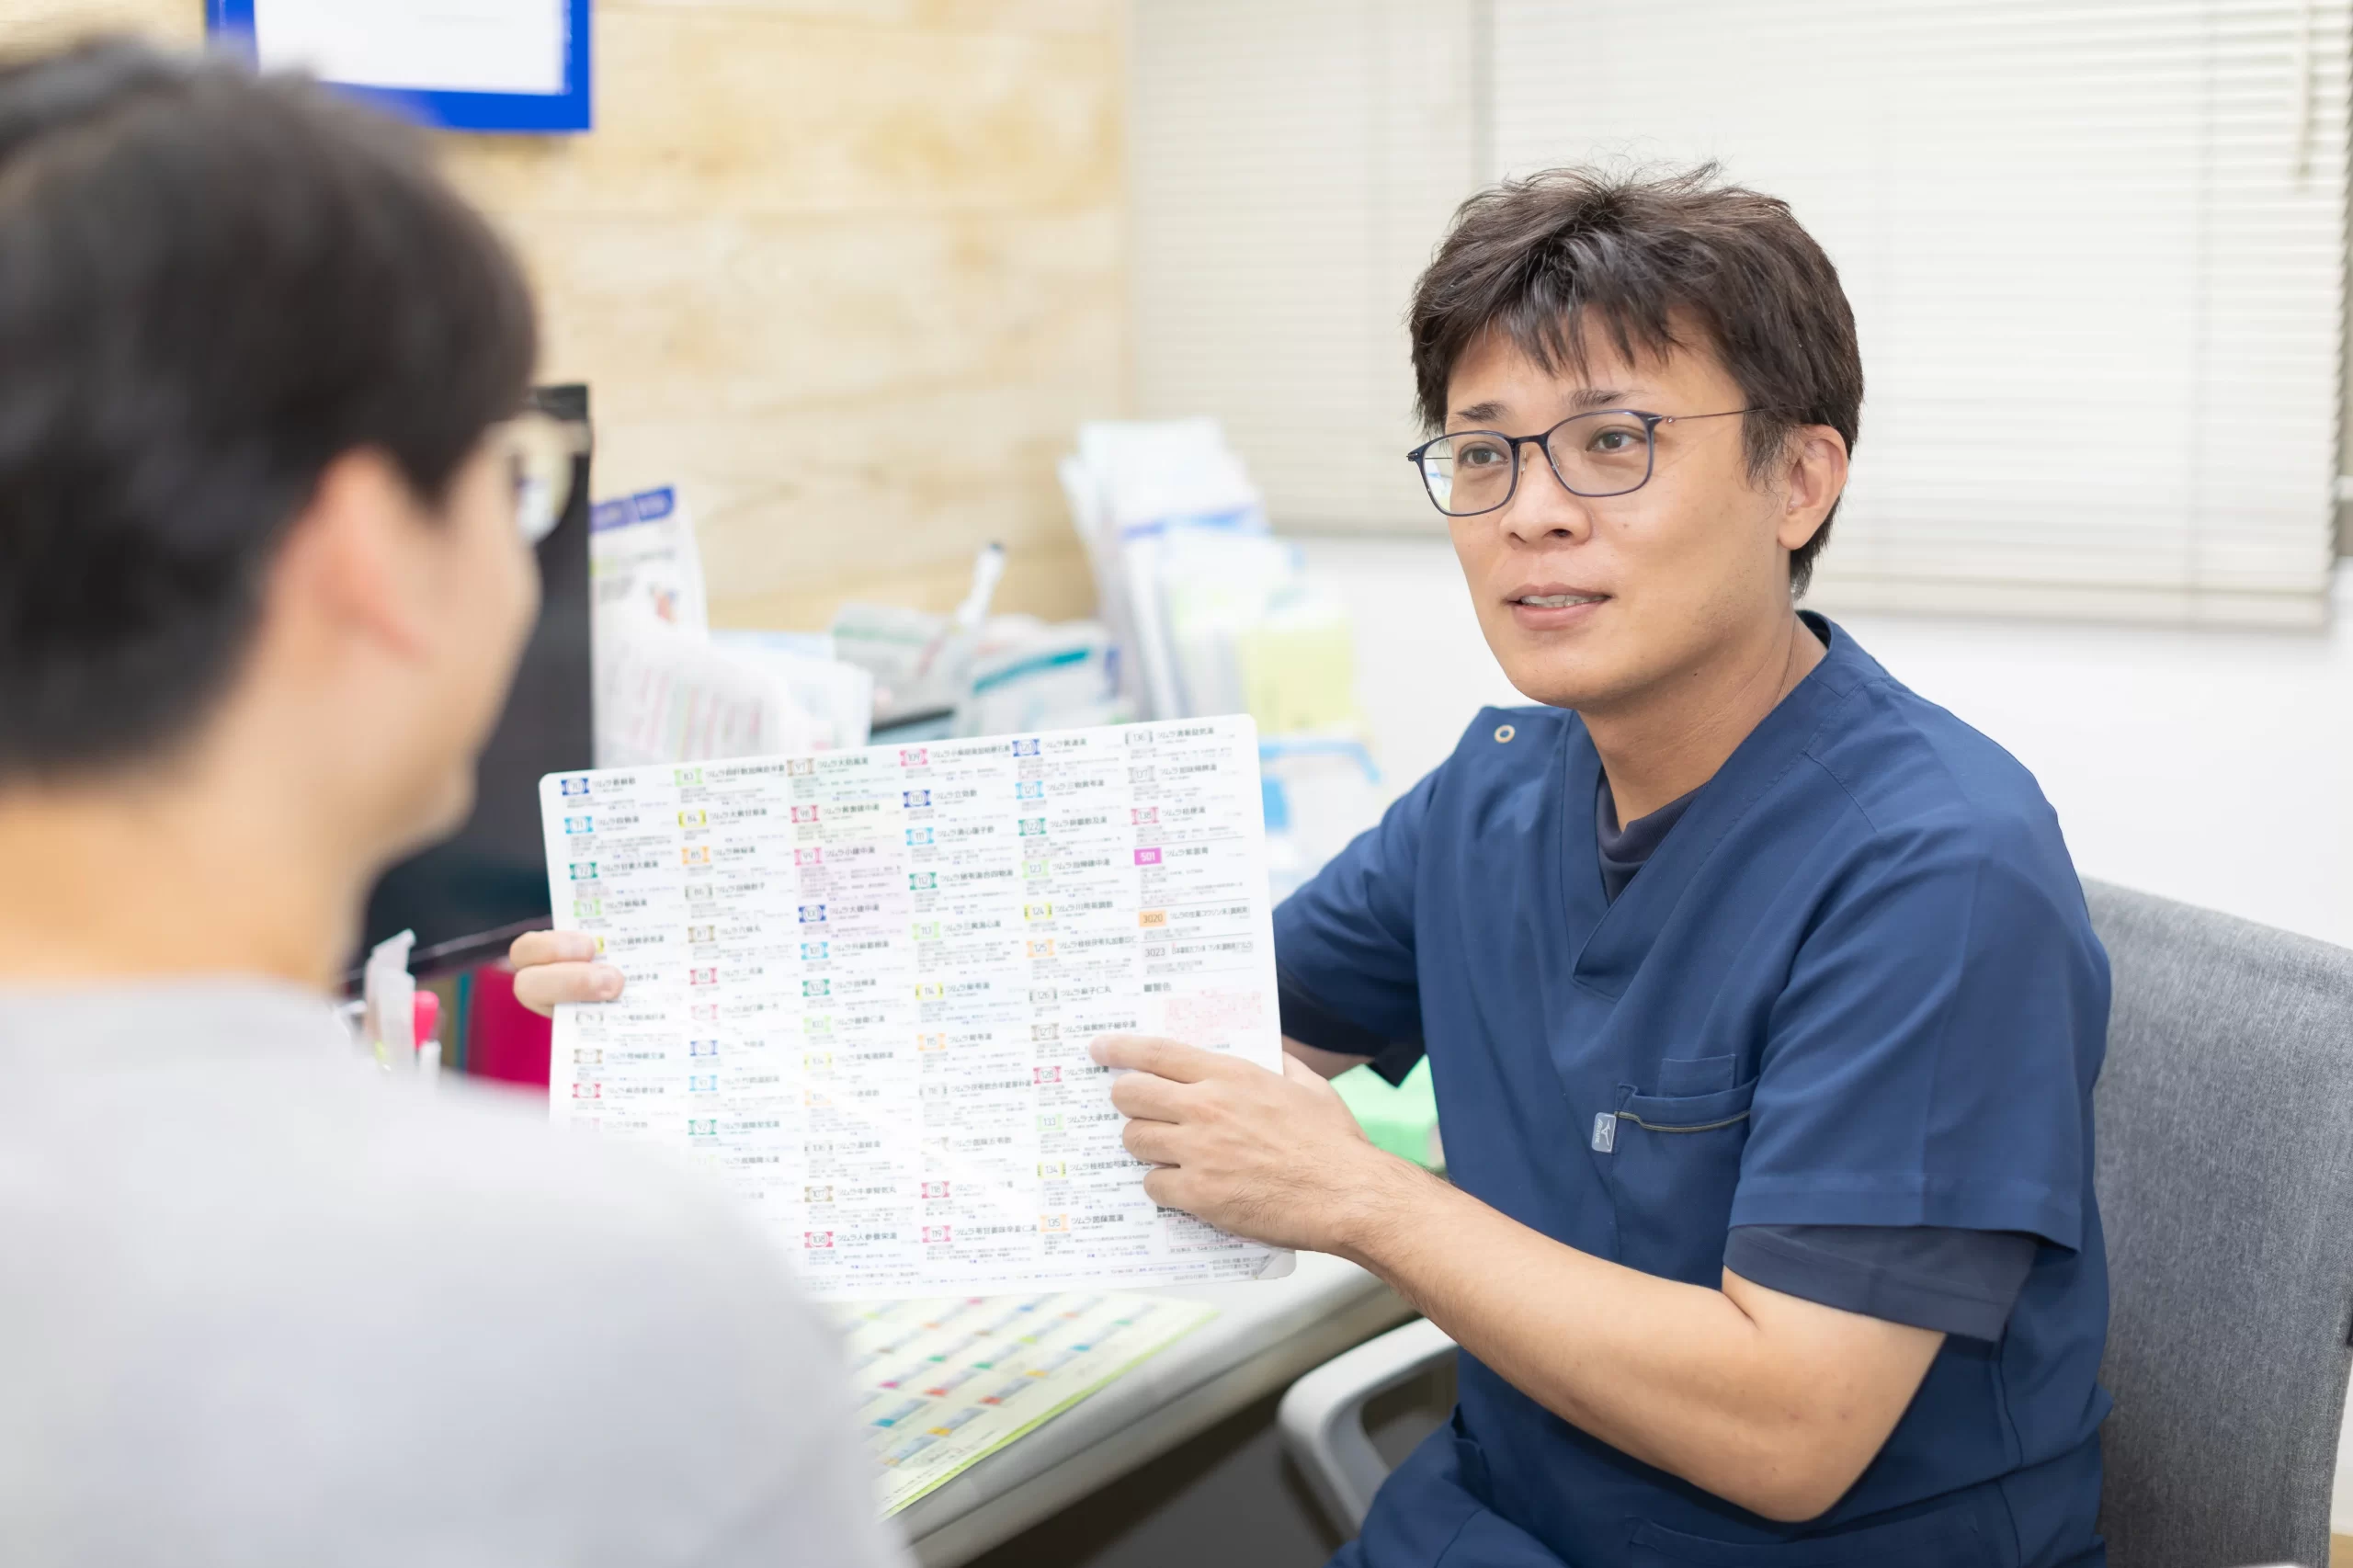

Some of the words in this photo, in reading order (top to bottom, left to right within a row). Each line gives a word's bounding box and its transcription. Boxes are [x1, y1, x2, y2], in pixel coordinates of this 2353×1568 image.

[1140, 852, 1154, 861] 501
[1143, 914, 1163, 924] 3020
[1145, 948, 1165, 957] 3023
[1048, 1219, 1060, 1227] 135
